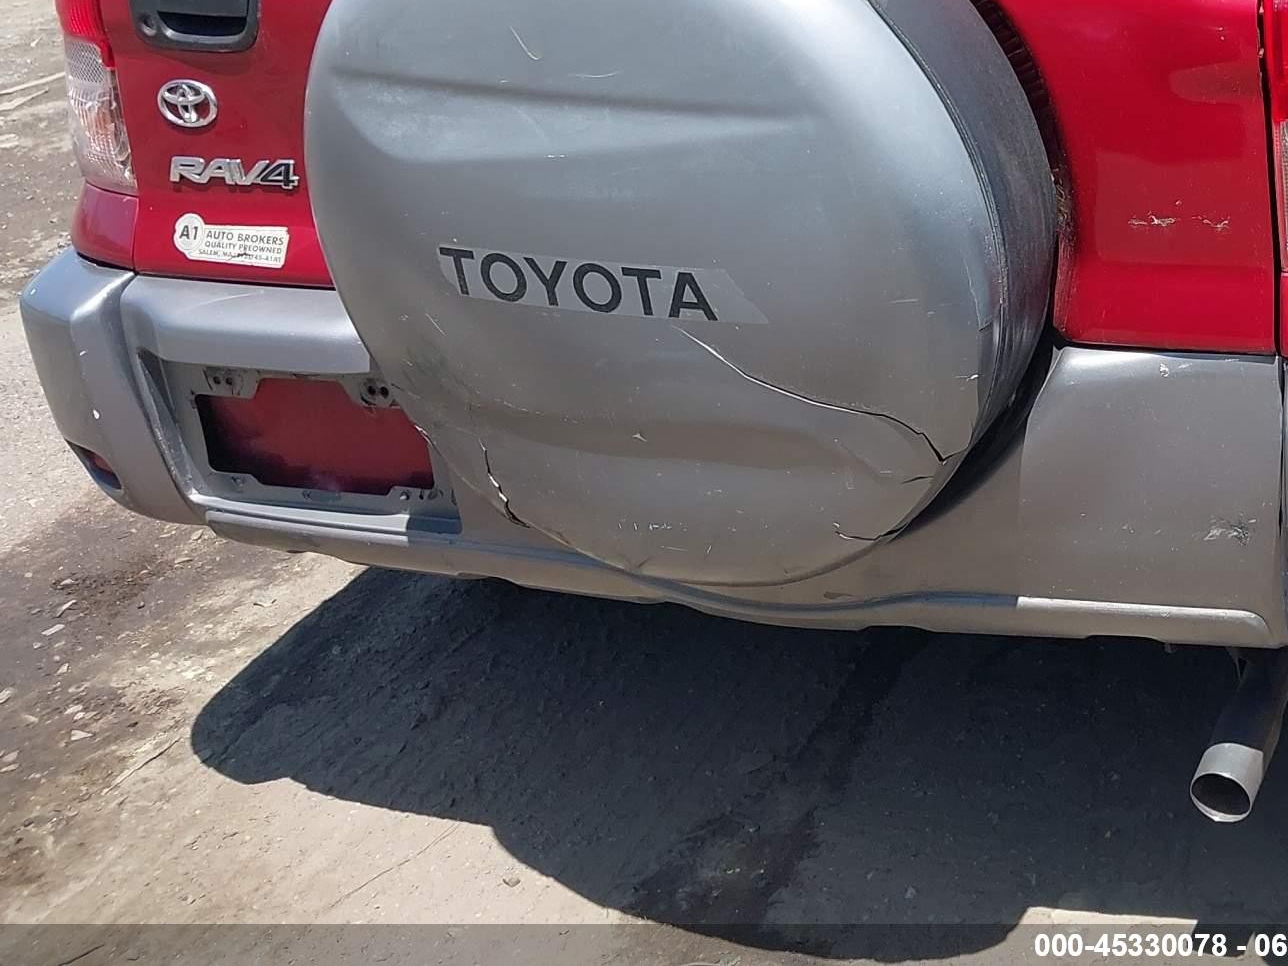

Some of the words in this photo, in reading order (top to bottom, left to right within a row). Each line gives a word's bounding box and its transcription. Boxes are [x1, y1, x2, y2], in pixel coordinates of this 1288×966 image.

[170, 156, 299, 189] RAV4
[179, 224, 199, 240] A1
[206, 230, 234, 241] AUTO
[237, 233, 284, 246] BROKERS
[205, 240, 237, 250] QUALITY
[439, 247, 718, 321] TOYOTA
